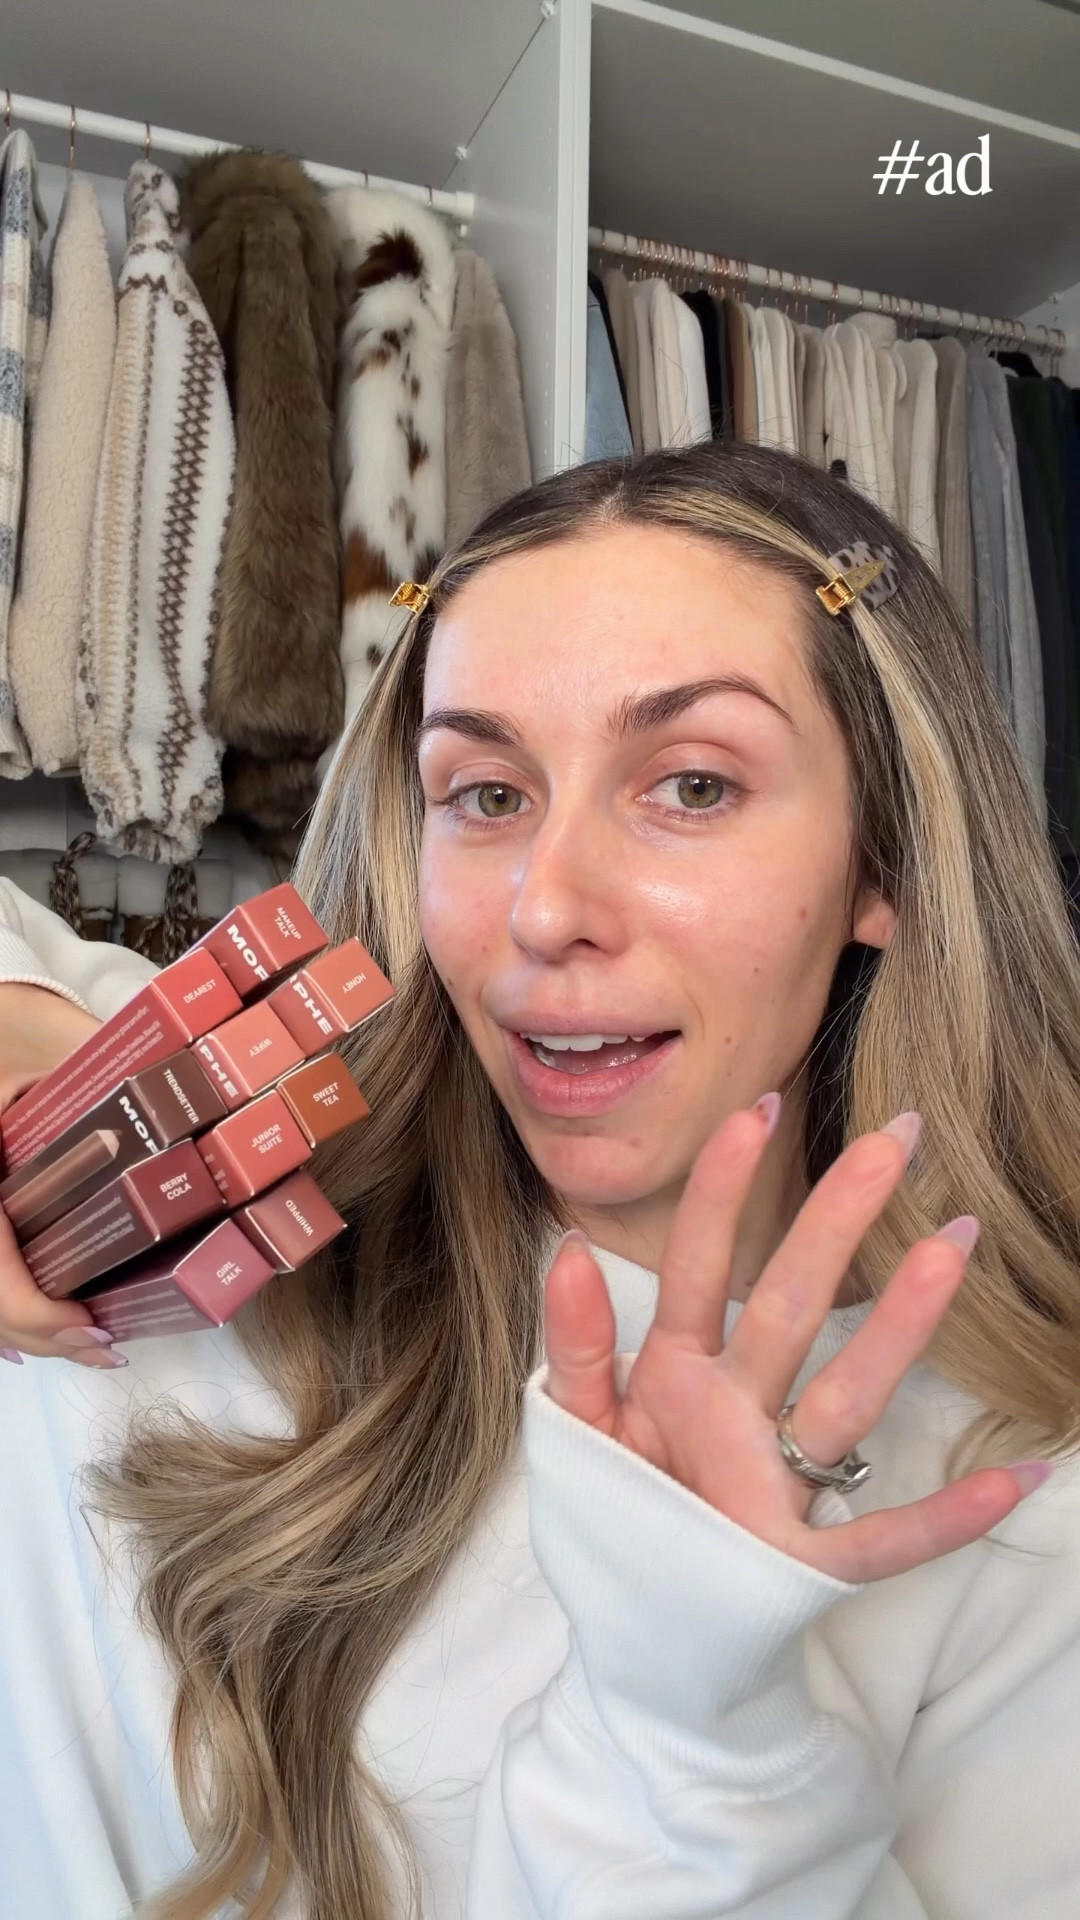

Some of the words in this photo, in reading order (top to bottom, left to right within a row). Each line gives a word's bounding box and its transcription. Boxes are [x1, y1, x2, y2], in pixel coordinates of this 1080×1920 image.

[274, 916, 291, 938] TALK
[276, 907, 302, 940] MAKEUP
[183, 979, 216, 1004] DEAREST
[342, 973, 366, 993] HONEY
[250, 1038, 273, 1057] WIFEY
[163, 1068, 200, 1124] TRENDSETTER
[313, 1082, 339, 1102] SWEET
[322, 1095, 339, 1107] TEA
[252, 1124, 281, 1147] JUNIOR
[258, 1134, 283, 1154] SUITE
[160, 1172, 188, 1193] BERRY
[166, 1183, 192, 1200] COLA
[286, 1200, 314, 1236] WHIPPED
[216, 1261, 236, 1278] GIRL
[221, 1266, 243, 1286] TALK
